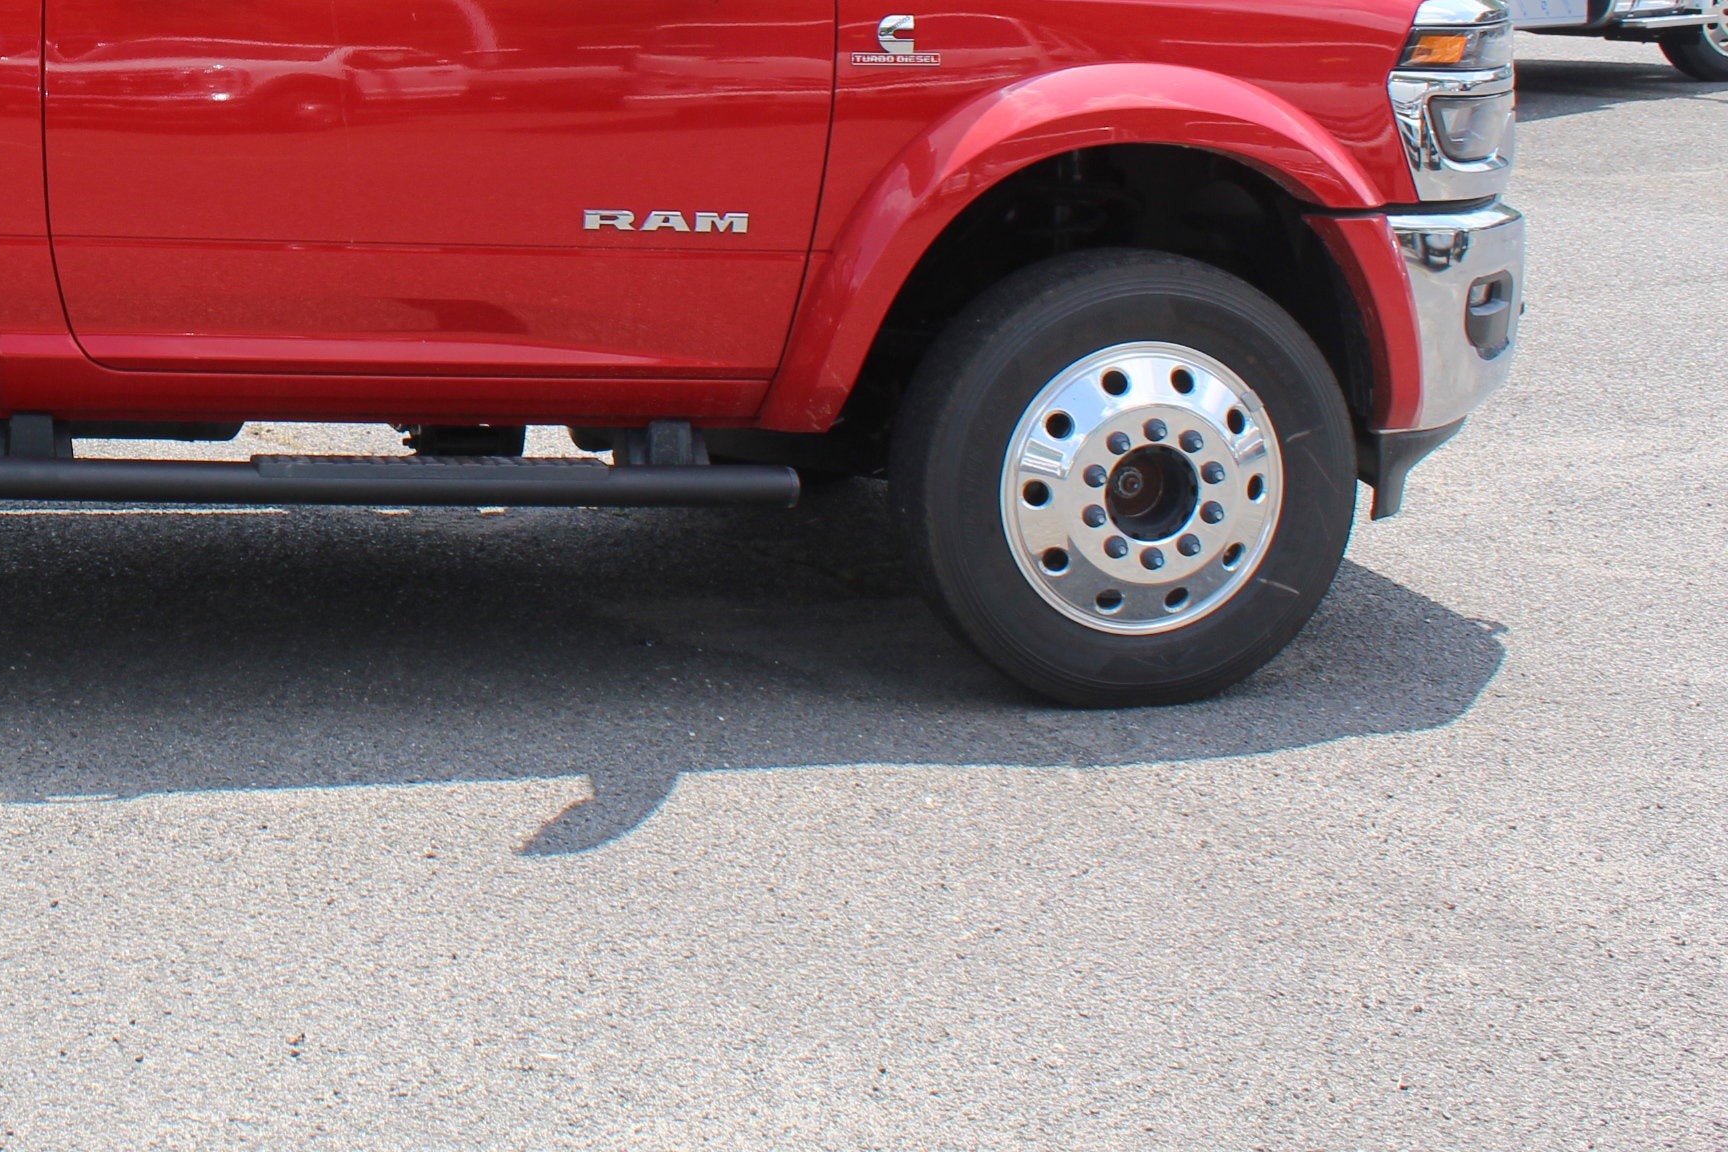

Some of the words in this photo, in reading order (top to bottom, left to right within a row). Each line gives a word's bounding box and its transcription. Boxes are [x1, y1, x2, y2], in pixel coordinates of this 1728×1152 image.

[854, 55, 894, 63] TURBO
[896, 55, 938, 63] DIESEL
[583, 209, 750, 234] RAM
